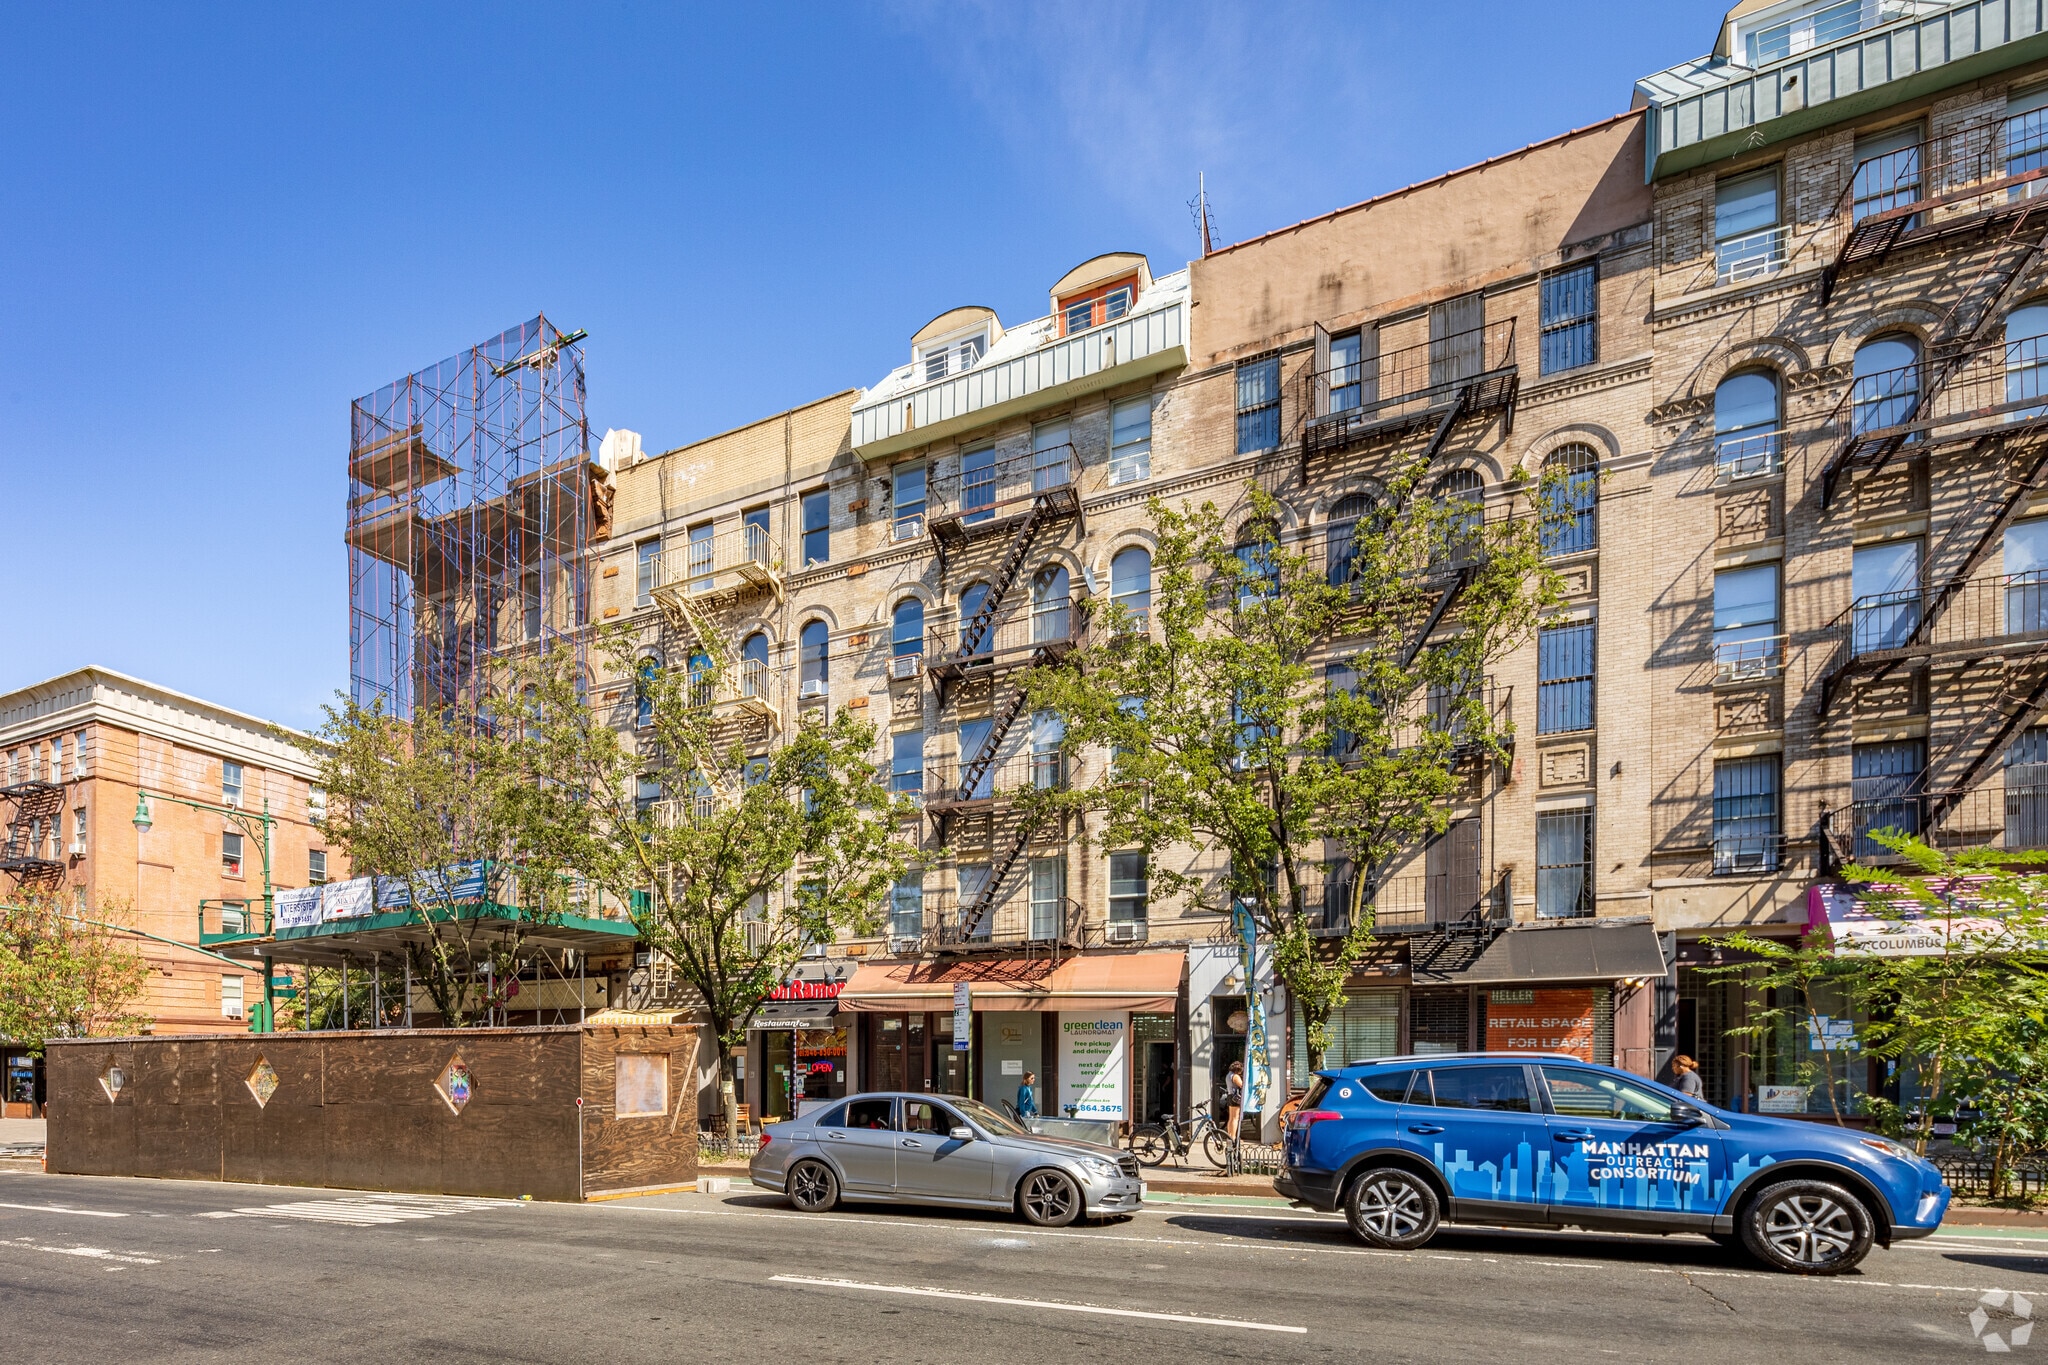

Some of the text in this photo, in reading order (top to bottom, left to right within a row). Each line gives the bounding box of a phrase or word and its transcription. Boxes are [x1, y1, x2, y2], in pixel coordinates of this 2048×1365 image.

[280, 901, 317, 918] INTERSYSTEM
[1871, 939, 1942, 950] COLUMBUS
[1491, 989, 1533, 1001] HELLER
[1237, 912, 1272, 1106] LAUDROMAT
[753, 1019, 800, 1029] Restaurant
[1063, 1019, 1123, 1032] greenclean
[1489, 1018, 1592, 1028] RETAIL SPACE
[1508, 1038, 1590, 1048] FOR LEASE
[811, 1063, 833, 1073] OPEN
[1581, 1141, 1710, 1159] MANHATTAN
[1606, 1156, 1684, 1169] OUTREACH
[1590, 1167, 1701, 1185] CONSORTIUM
